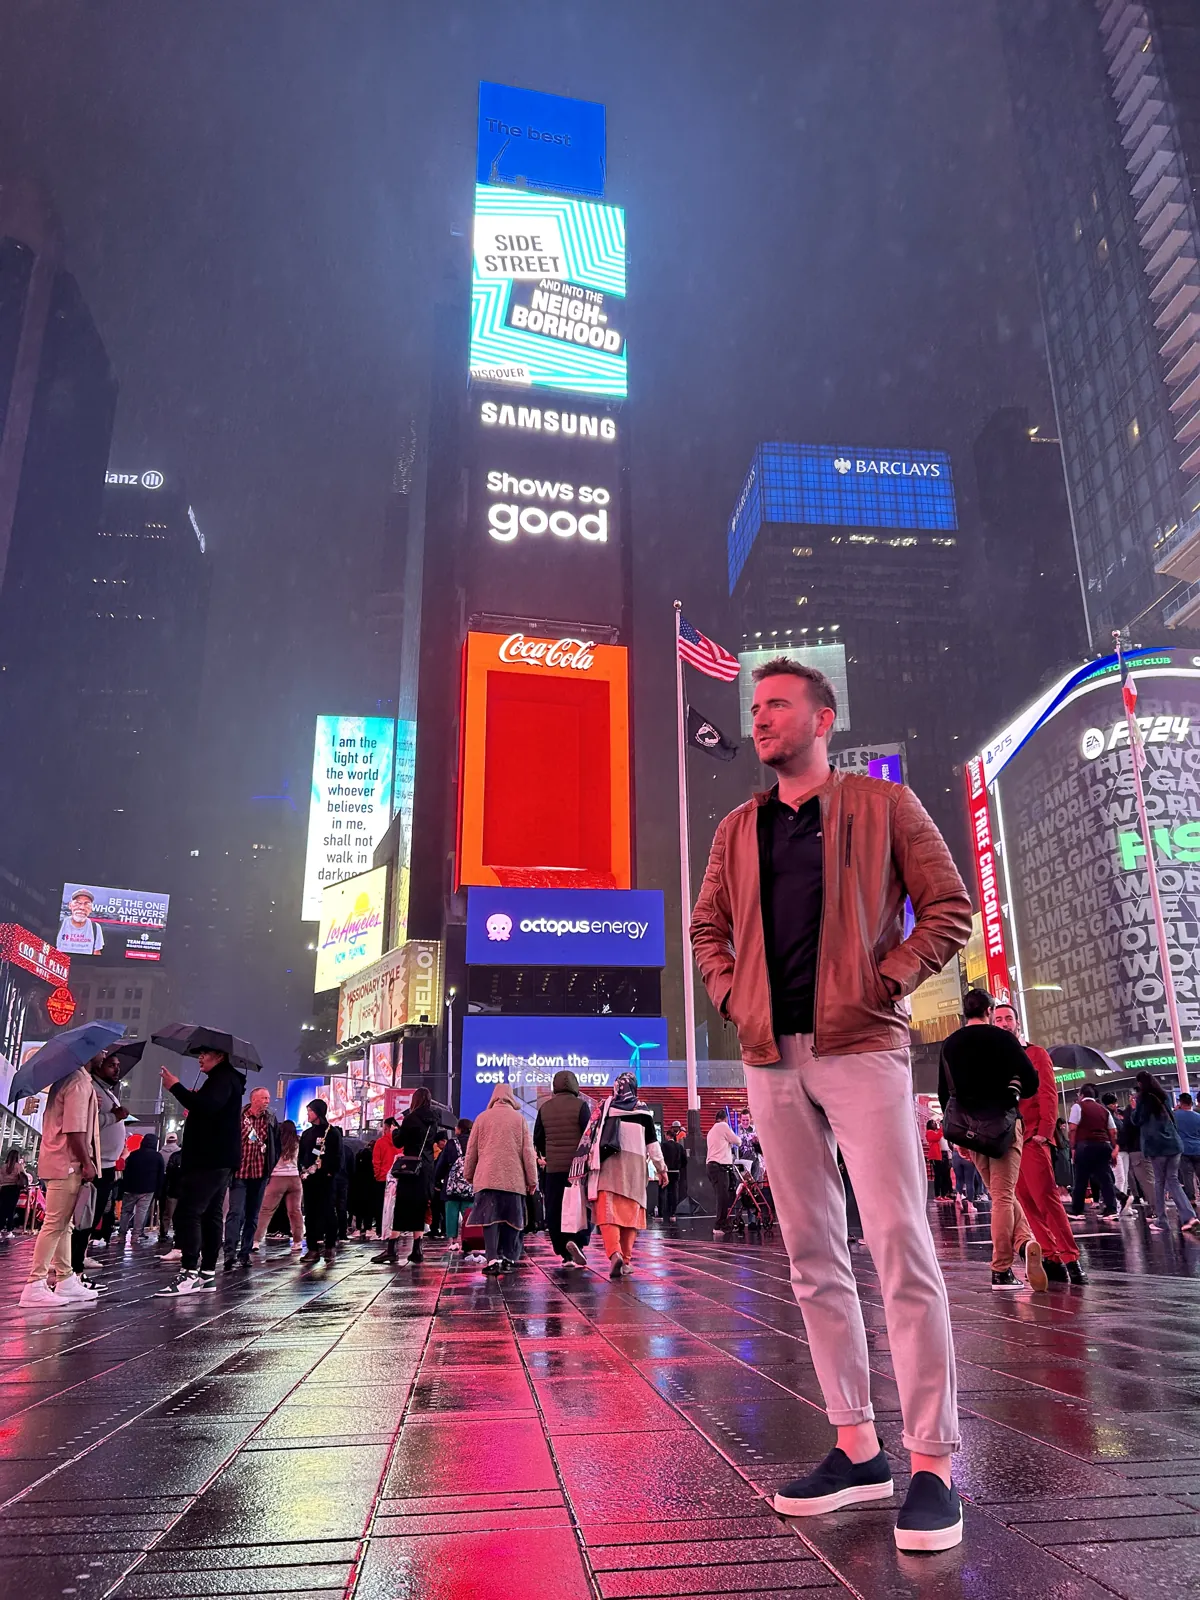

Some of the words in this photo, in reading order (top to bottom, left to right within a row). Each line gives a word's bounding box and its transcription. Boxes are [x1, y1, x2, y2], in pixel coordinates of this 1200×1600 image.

[485, 117, 522, 137] The
[527, 126, 572, 147] best
[494, 234, 543, 252] SIDE
[484, 254, 560, 273] STREET
[539, 278, 561, 292] AND
[561, 283, 584, 299] INTO
[585, 288, 604, 304] THE
[531, 289, 607, 326] NEIGH-
[511, 305, 620, 352] BORHOOD
[470, 367, 525, 379] DISCOVER
[481, 402, 616, 439] SAMSUNG
[856, 460, 940, 477] BARCLAYS
[578, 485, 611, 505] so
[488, 502, 608, 543] good
[498, 633, 597, 670] Coca-Cola
[1143, 657, 1171, 665] CLUB
[332, 735, 335, 748] I
[339, 738, 356, 748] am
[360, 736, 377, 748] the
[334, 752, 358, 767] light
[362, 753, 373, 764] of
[326, 768, 343, 779] the
[347, 769, 379, 781] world
[327, 784, 376, 797] whoever
[327, 800, 374, 813] believes
[332, 817, 342, 829] in
[974, 806, 992, 851] FREE
[1060, 812, 1097, 849] THE
[323, 834, 351, 847] shall
[355, 835, 373, 847] not
[326, 851, 354, 863] walk
[357, 852, 367, 864] in
[1040, 876, 1075, 906] THE
[1073, 884, 1113, 915] THE
[92, 904, 116, 914] WHO
[117, 907, 165, 918] ANSWERS
[109, 898, 122, 907] BE
[124, 899, 143, 909] THE
[145, 901, 166, 911] ONE
[978, 851, 1003, 958] CHOCOLATE
[119, 915, 139, 924] THE
[140, 917, 164, 926] CALL
[1089, 896, 1183, 938] GAME
[322, 919, 340, 949] Los
[339, 907, 382, 945] Angeles
[1061, 943, 1098, 976] THE
[380, 964, 401, 988] STYLE
[1080, 959, 1121, 992] THE
[1071, 990, 1109, 1021] THE
[1067, 1012, 1123, 1046] GAME
[1124, 1002, 1200, 1032] THE
[528, 1053, 564, 1067] down
[567, 1053, 589, 1067] the
[1125, 1058, 1146, 1069] PLAY
[1147, 1056, 1178, 1067] FROM
[476, 1071, 505, 1084] cost
[508, 1071, 522, 1083] of
